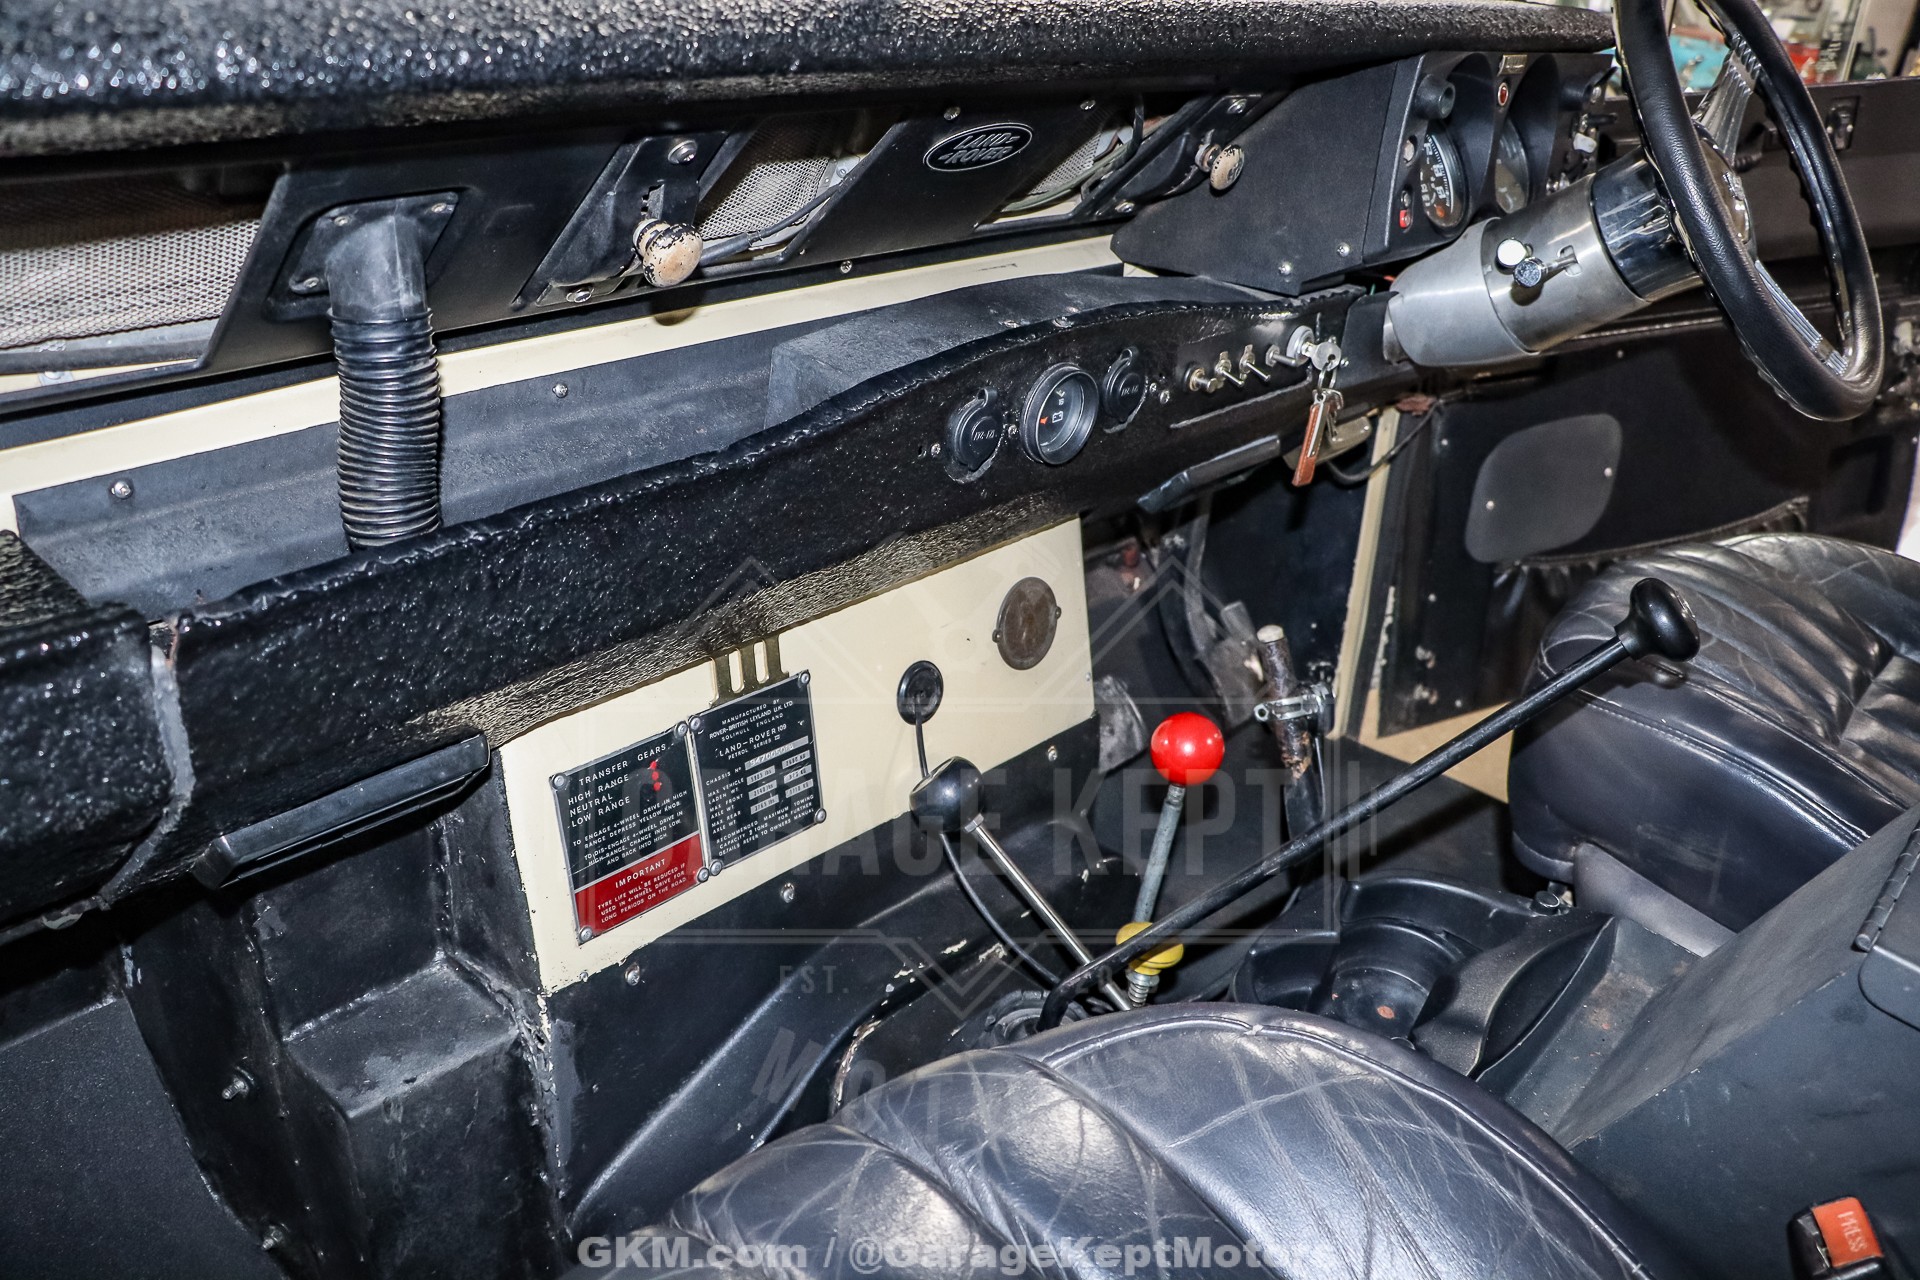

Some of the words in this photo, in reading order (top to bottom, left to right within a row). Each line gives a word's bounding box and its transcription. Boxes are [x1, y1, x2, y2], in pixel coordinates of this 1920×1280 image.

[721, 727, 750, 742] SOLIHULL
[756, 713, 784, 728] ENGLAND
[722, 703, 767, 725] MANUFACTURED
[749, 709, 772, 723] LEYLAND
[777, 723, 787, 733] 109
[728, 748, 749, 760] PETROL
[753, 739, 772, 750] SERIES
[578, 760, 628, 786] TRANSFER
[637, 743, 666, 761] GEARS
[567, 789, 591, 806] HIGH
[597, 774, 629, 793] RANGE
[706, 771, 731, 786] CHASSIS
[707, 789, 720, 797] MAX
[722, 777, 744, 791] VEHICLE
[569, 792, 613, 818] NEUTRAL
[571, 812, 591, 828] LOW
[597, 796, 631, 816] RANGE
[708, 793, 727, 804] LADEN
[709, 804, 721, 812] MAX
[725, 793, 744, 805] FRONT
[573, 839, 582, 847] TO
[584, 825, 611, 842] ENGAGE
[613, 812, 640, 828] 4-WHEEL
[643, 802, 661, 815] DRIVE
[662, 797, 671, 806] IN
[672, 790, 687, 801] HIGH
[710, 810, 724, 819] AXLE
[711, 819, 724, 828] MAX
[726, 810, 741, 820] REAR
[716, 820, 759, 844] RECOMMENDED
[763, 806, 789, 821] MAXIMUM
[793, 794, 814, 807] TOWING
[719, 832, 746, 849] CAPACITY
[754, 822, 768, 832] TONS
[777, 812, 789, 821] FOR
[790, 802, 812, 815] FURTHER
[584, 836, 606, 849] RANGE
[609, 821, 637, 838] DEPRESS
[639, 809, 662, 824] YELLOW
[584, 854, 592, 862] TO
[594, 836, 630, 856] DIS-ENGAGE
[632, 822, 658, 838] 4-WHEEL
[659, 814, 675, 826] DRIVE
[676, 810, 684, 818] IN
[629, 832, 652, 847] CHANGE
[654, 825, 667, 835] INTO
[712, 825, 726, 834] AXLE
[718, 844, 740, 857] DETAILS
[743, 834, 759, 845] REFER
[761, 828, 768, 836] TO
[769, 818, 791, 832] OWNERS
[793, 808, 814, 820] MANUAL
[607, 856, 619, 865] AND
[621, 847, 637, 858] BACK
[639, 840, 652, 850] INTO
[615, 858, 666, 889] IMPORTANT
[598, 899, 612, 910] TYRE
[614, 892, 627, 902] LIFE
[628, 885, 642, 895] WILL
[653, 866, 679, 883] REDUCED
[601, 906, 617, 916] USED
[654, 877, 671, 889] DRIVE
[673, 870, 685, 879] FOR
[601, 913, 617, 923] LONG
[620, 899, 645, 914] PERIODS
[647, 892, 656, 900] ON
[658, 886, 669, 895] THE
